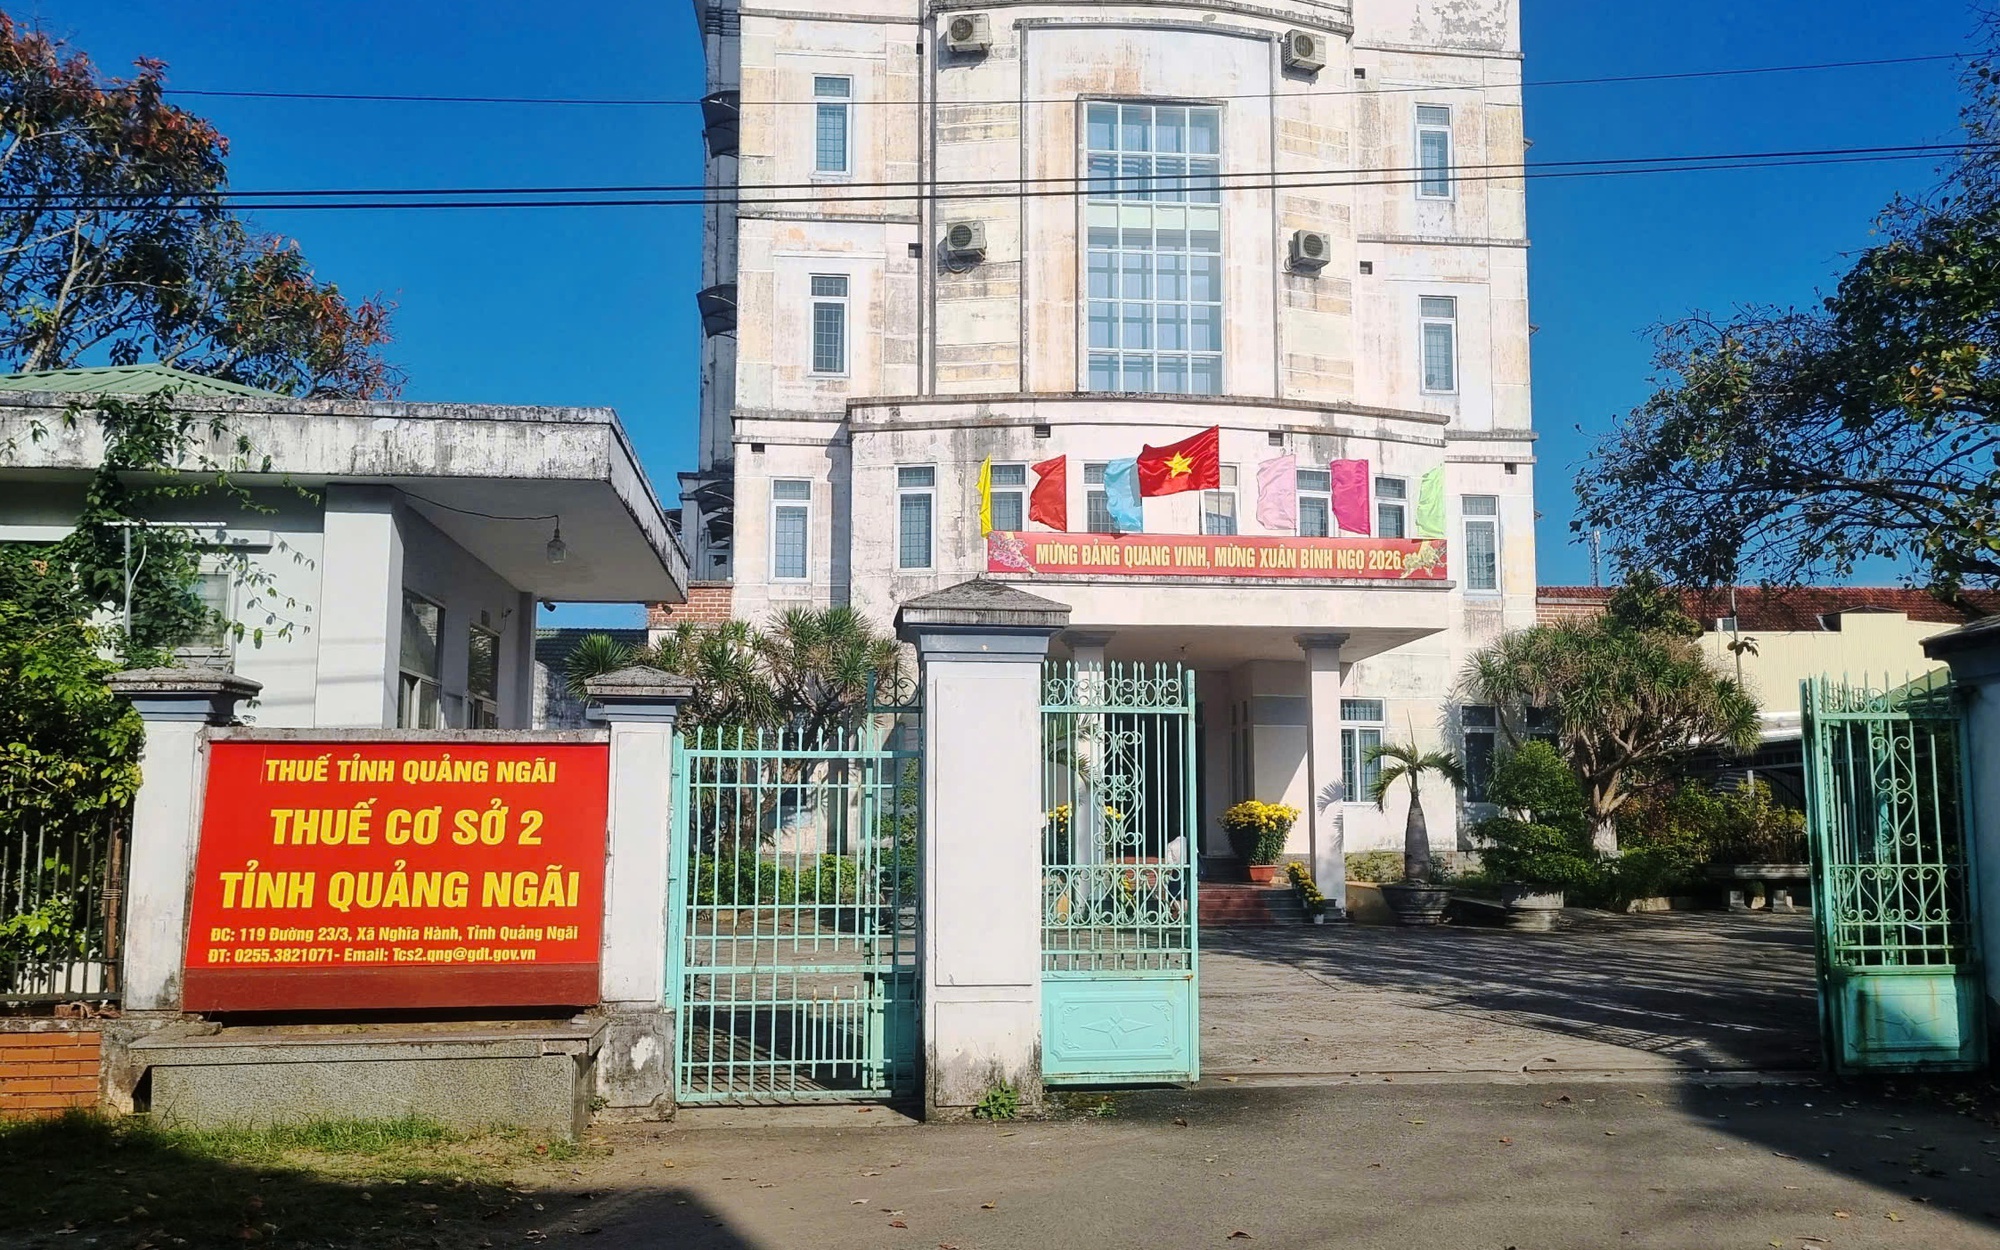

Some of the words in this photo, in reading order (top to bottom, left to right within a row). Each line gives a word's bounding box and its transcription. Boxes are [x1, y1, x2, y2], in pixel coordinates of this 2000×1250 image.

[1035, 540, 1078, 565] MỪNG
[1081, 538, 1120, 566] ĐẢNG
[1123, 545, 1170, 568] QUANG
[1174, 546, 1211, 569] VINH,
[1214, 543, 1256, 568] MỪNG
[1259, 544, 1297, 569] XUÂN
[1300, 545, 1333, 569] BÍNH
[1336, 549, 1365, 574] NGỌ
[1368, 550, 1401, 570] 2026
[266, 754, 330, 782] THUẾ
[337, 753, 395, 782] TỈNH
[402, 754, 488, 785] QUẢNG
[496, 756, 556, 783] NGÃI
[271, 798, 378, 845] THUẾ
[385, 805, 442, 845] CƠ
[452, 798, 510, 845] SỞ
[518, 810, 543, 845] 2
[219, 860, 316, 908] TỈNH
[328, 859, 469, 913] QUẢNG
[481, 864, 580, 908] NGÃI
[210, 928, 235, 942] ĐC:
[240, 927, 266, 942] 119
[269, 927, 314, 943] Đường
[317, 927, 352, 943] 23/3,
[356, 927, 375, 941] Xã
[378, 926, 420, 942] Nghĩa
[423, 926, 463, 941] Hành,
[467, 925, 496, 940] Tỉnh
[500, 925, 543, 941] Quảng
[547, 926, 578, 941] Ngãi
[208, 949, 230, 962] ĐT:
[344, 948, 389, 962] Email:
[392, 947, 536, 962] Tcs2.qng@gdt.gov.vn
